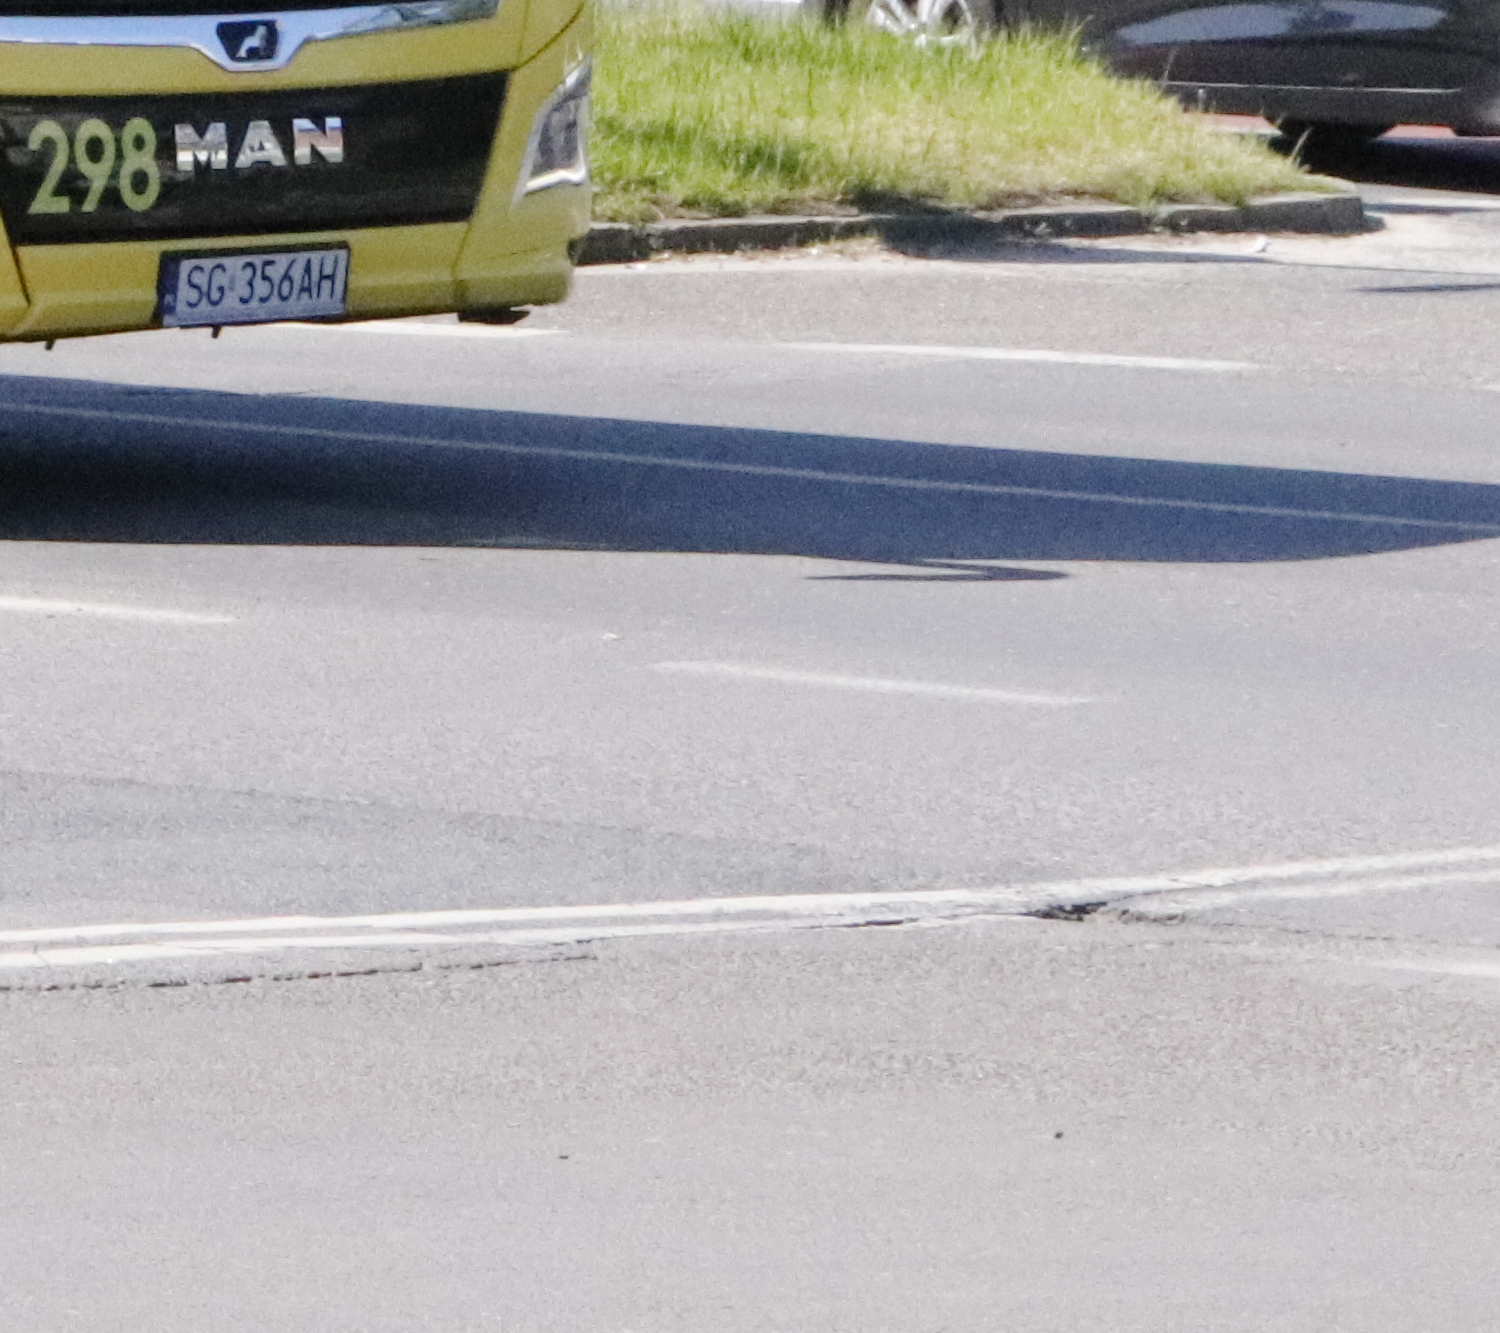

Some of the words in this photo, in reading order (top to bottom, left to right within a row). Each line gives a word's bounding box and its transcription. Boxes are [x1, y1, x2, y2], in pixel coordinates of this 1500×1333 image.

[27, 117, 161, 214] 298
[174, 116, 344, 172] MAN
[186, 263, 226, 308] SG
[239, 254, 339, 304] 356AH
